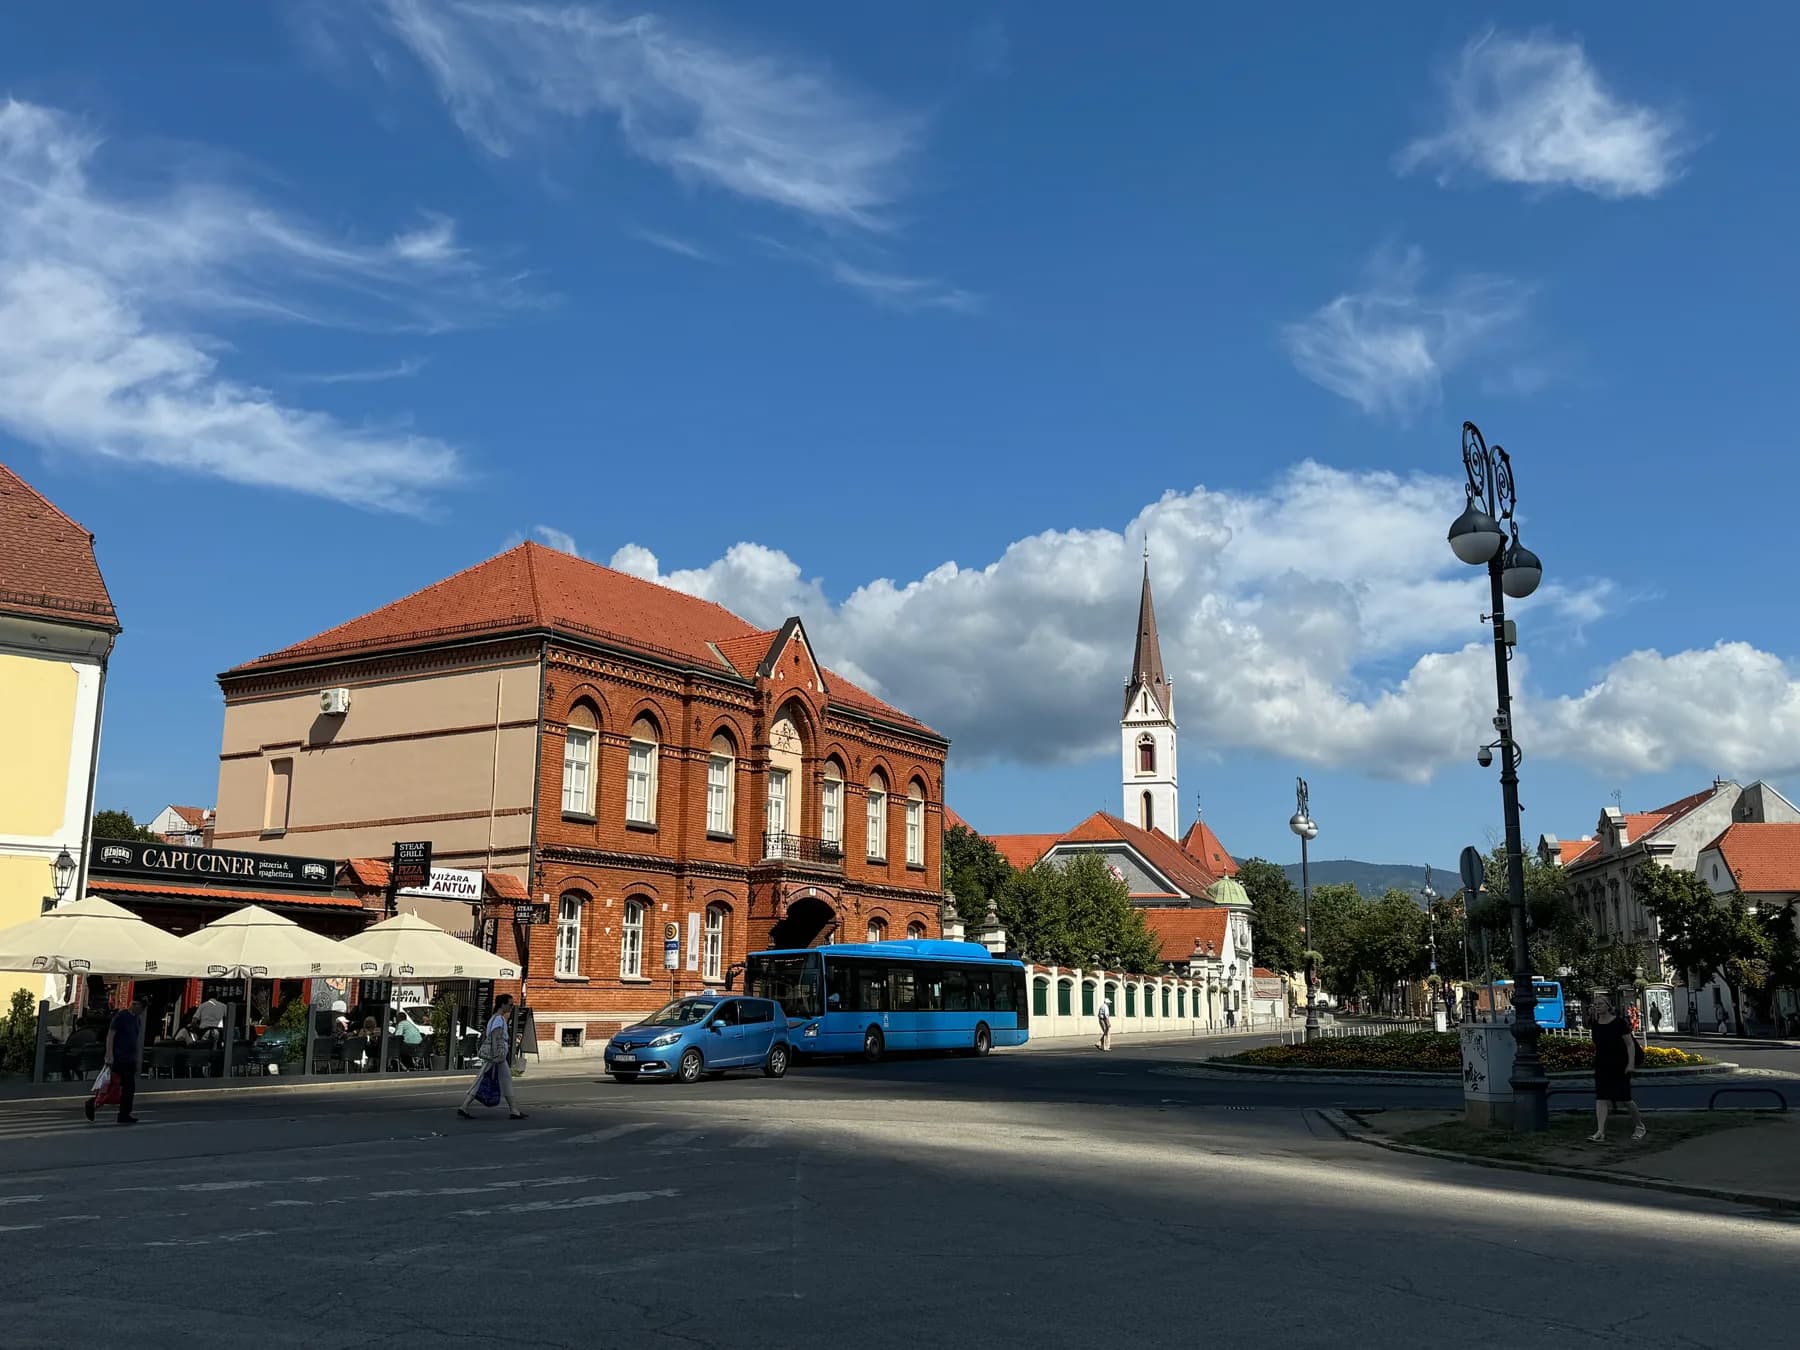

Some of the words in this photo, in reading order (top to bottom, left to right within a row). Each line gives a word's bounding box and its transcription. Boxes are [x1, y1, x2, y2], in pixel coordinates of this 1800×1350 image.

[399, 842, 425, 851] STEAK
[400, 850, 424, 858] GRILL
[142, 848, 254, 876] CAPUCINER
[258, 860, 282, 869] pizzeria
[283, 862, 289, 870] &
[398, 865, 423, 875] PIZZA
[429, 872, 469, 883] NJIŽARA
[432, 881, 477, 895] ANTUN
